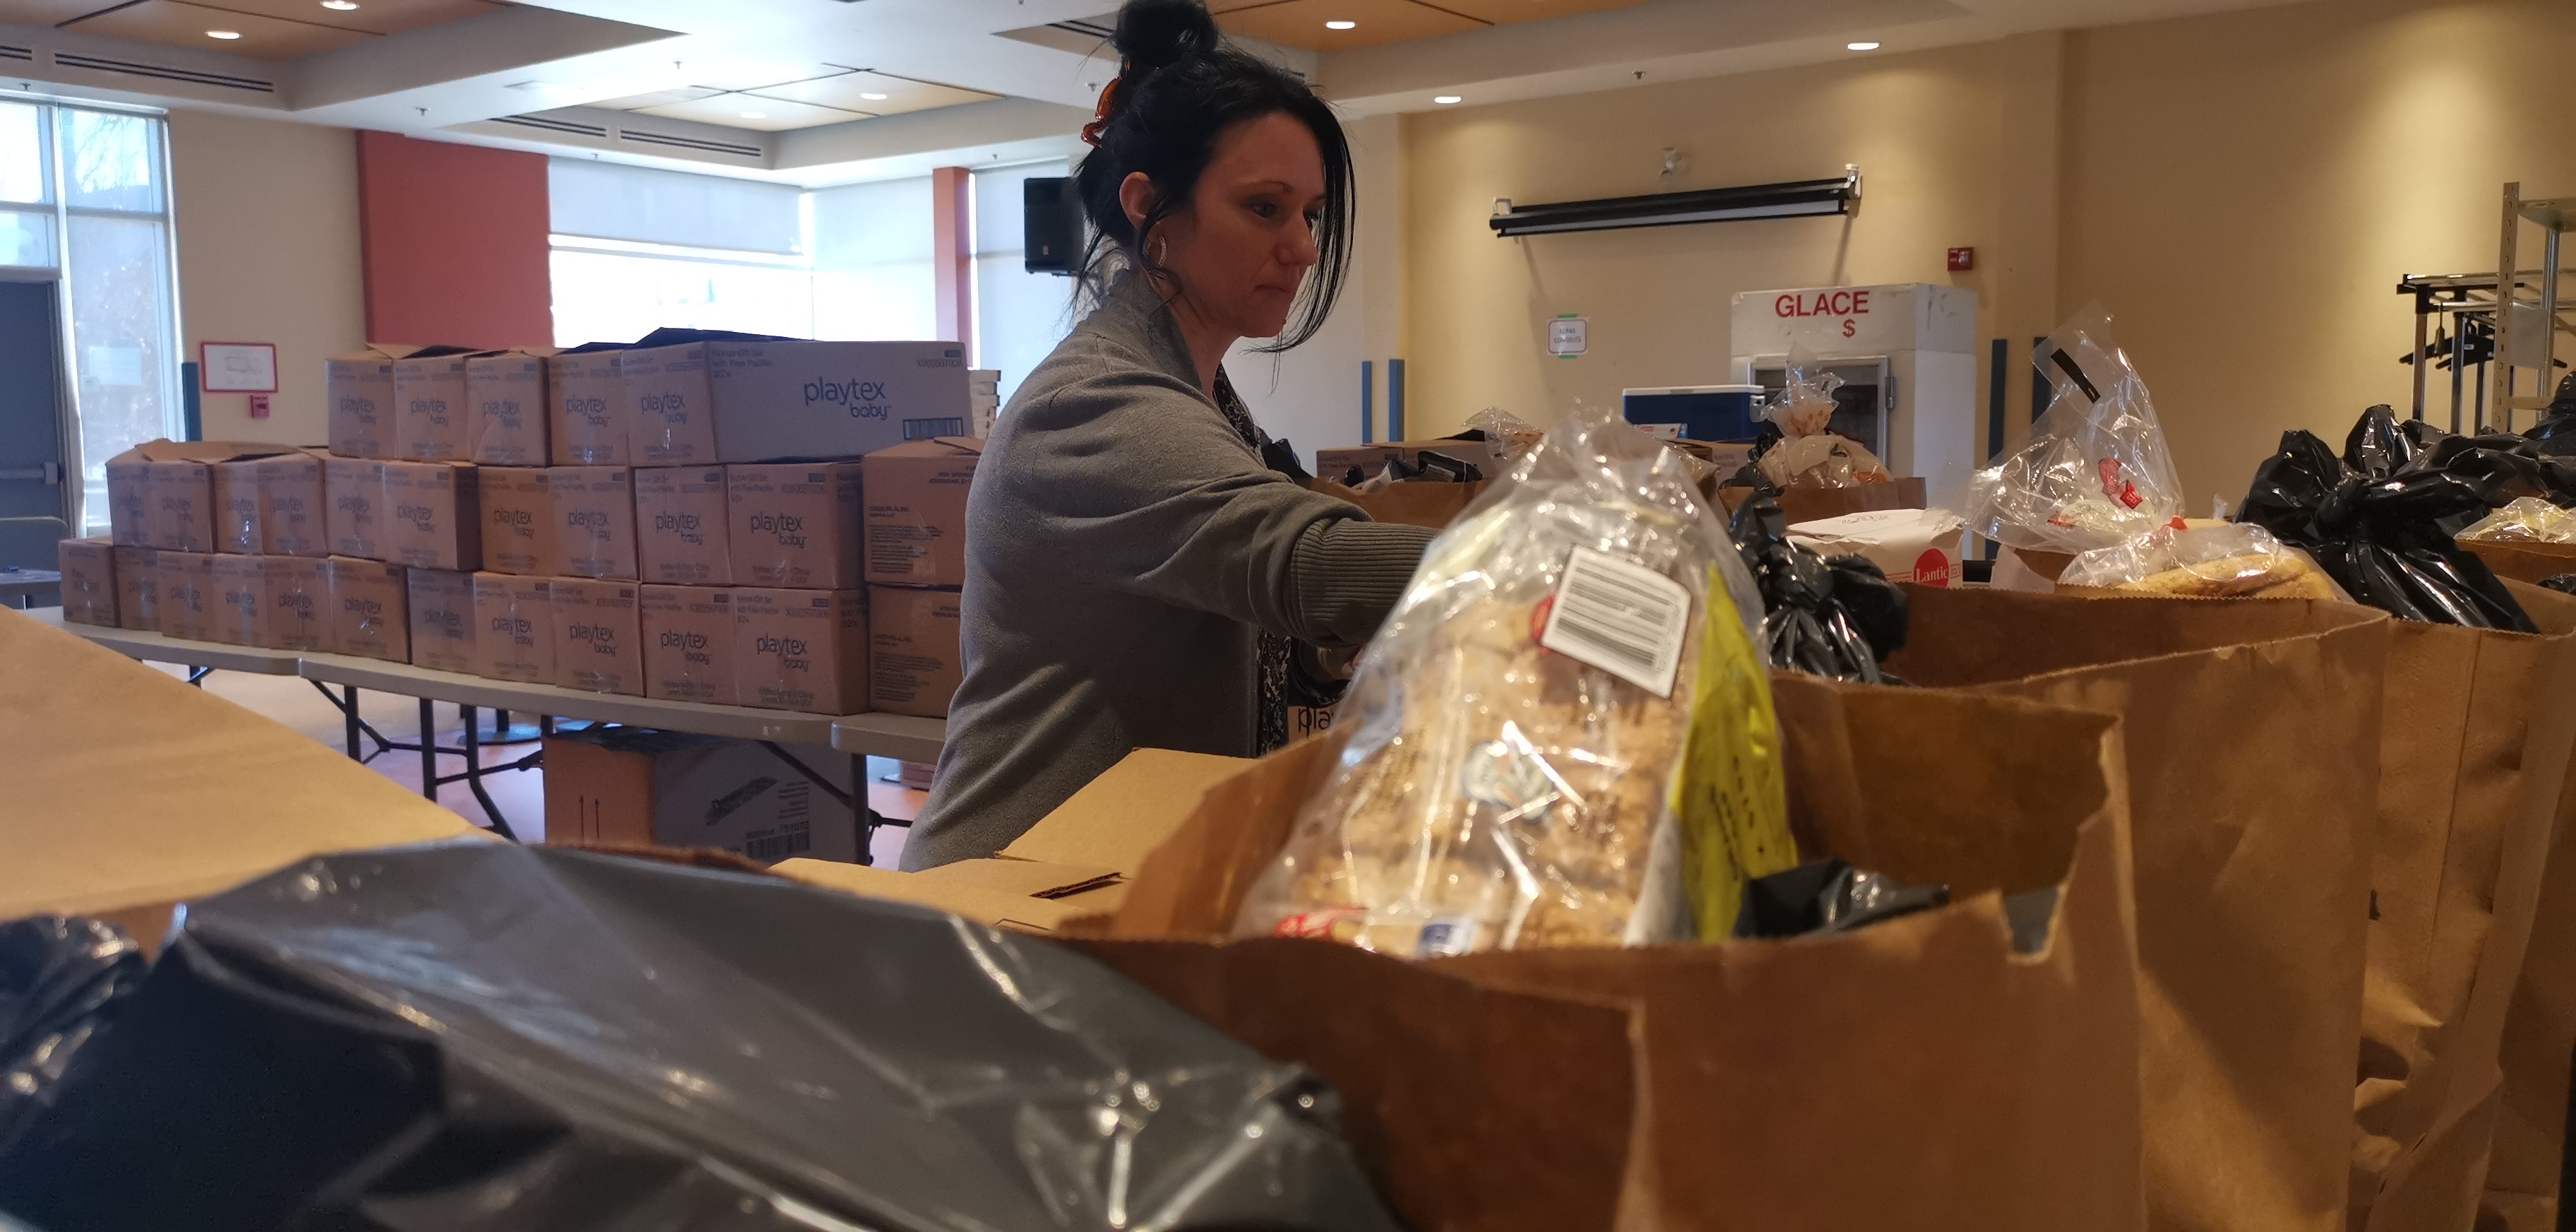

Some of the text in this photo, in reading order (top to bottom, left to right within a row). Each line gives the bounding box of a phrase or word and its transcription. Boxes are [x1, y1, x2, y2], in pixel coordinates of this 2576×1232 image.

[1775, 290, 1870, 318] GLACE
[1842, 318, 1856, 338] $
[804, 376, 887, 406] playtex
[566, 394, 607, 415] playtex
[641, 391, 686, 415] playtex
[849, 402, 890, 421] baby
[494, 506, 532, 526] playtex
[655, 510, 701, 534] playtex
[750, 511, 804, 534] playtex
[779, 533, 806, 550] baby
[1916, 566, 1949, 583] Lantic
[569, 621, 614, 644] playtex
[660, 629, 709, 651] playtex
[756, 632, 808, 657] playtex
[1298, 708, 1333, 734] pla
